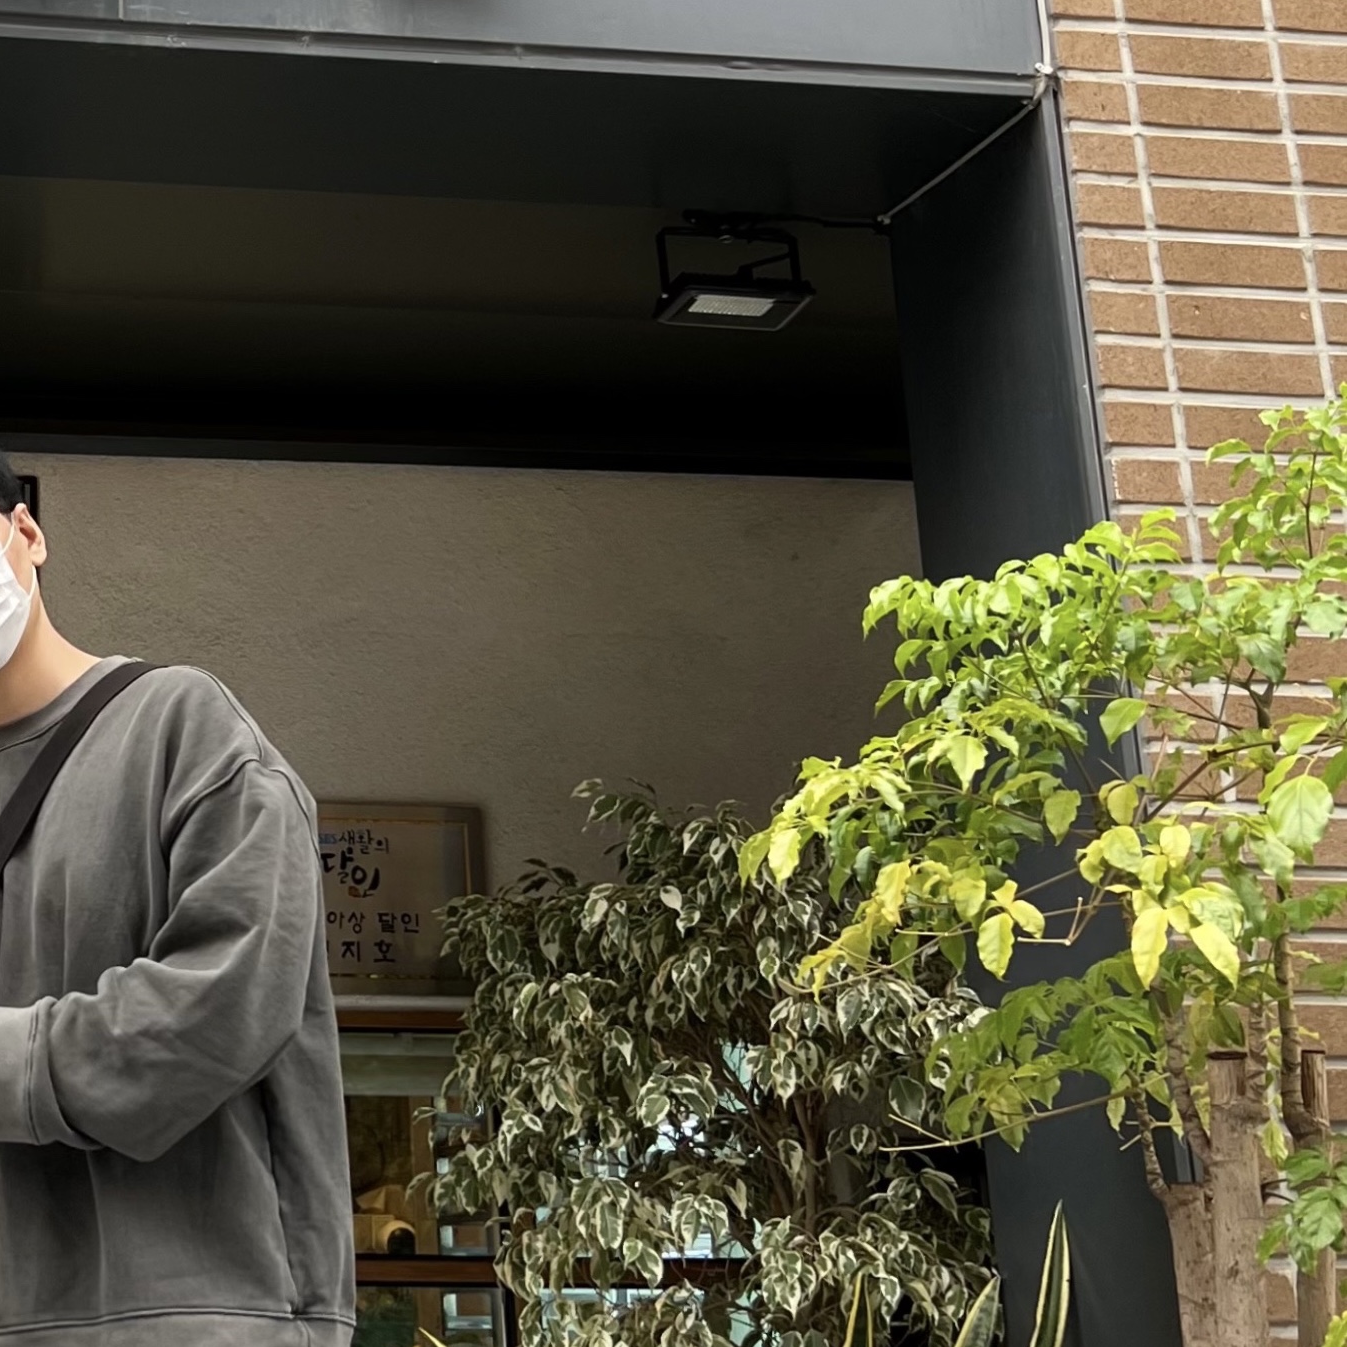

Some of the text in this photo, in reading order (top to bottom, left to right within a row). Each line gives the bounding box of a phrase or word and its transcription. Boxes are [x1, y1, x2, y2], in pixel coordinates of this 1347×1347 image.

[339, 829, 389, 854] 생활의
[321, 850, 380, 898] 달인
[326, 911, 419, 934] 아상 달인
